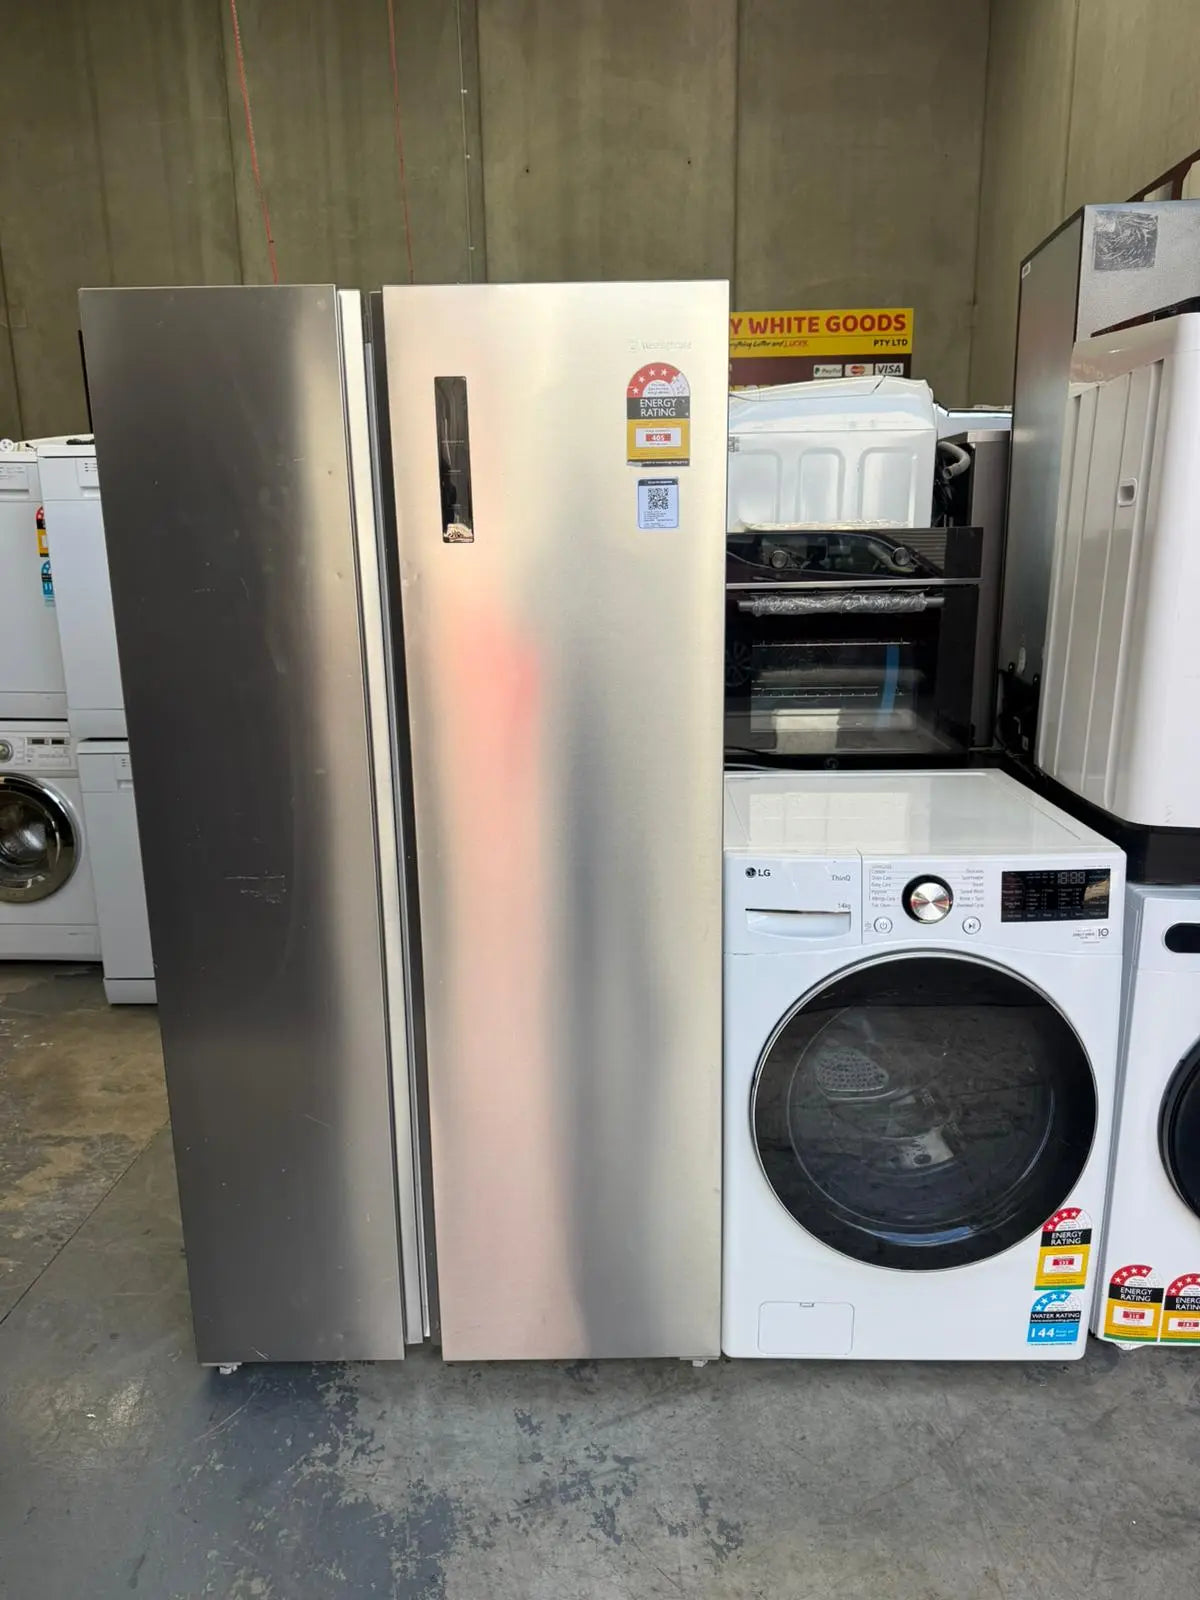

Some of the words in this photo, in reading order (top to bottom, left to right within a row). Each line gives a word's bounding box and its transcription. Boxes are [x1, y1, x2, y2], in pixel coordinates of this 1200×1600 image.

[730, 318, 743, 335] Y
[748, 316, 820, 335] WHITE
[825, 313, 906, 333] GOODS
[873, 339, 891, 347] PTY
[891, 338, 908, 347] LTD
[876, 364, 902, 375] VISA
[639, 398, 677, 409] ENERGY
[640, 408, 676, 417] RATING
[758, 868, 771, 877] LG
[1051, 1230, 1084, 1240] ENERGY
[1050, 1238, 1082, 1246] RATING
[1120, 1287, 1153, 1296] ENERGY
[1120, 1294, 1152, 1302] RATING
[1175, 1303, 1200, 1311] RATIN
[1030, 1327, 1056, 1338] 144
